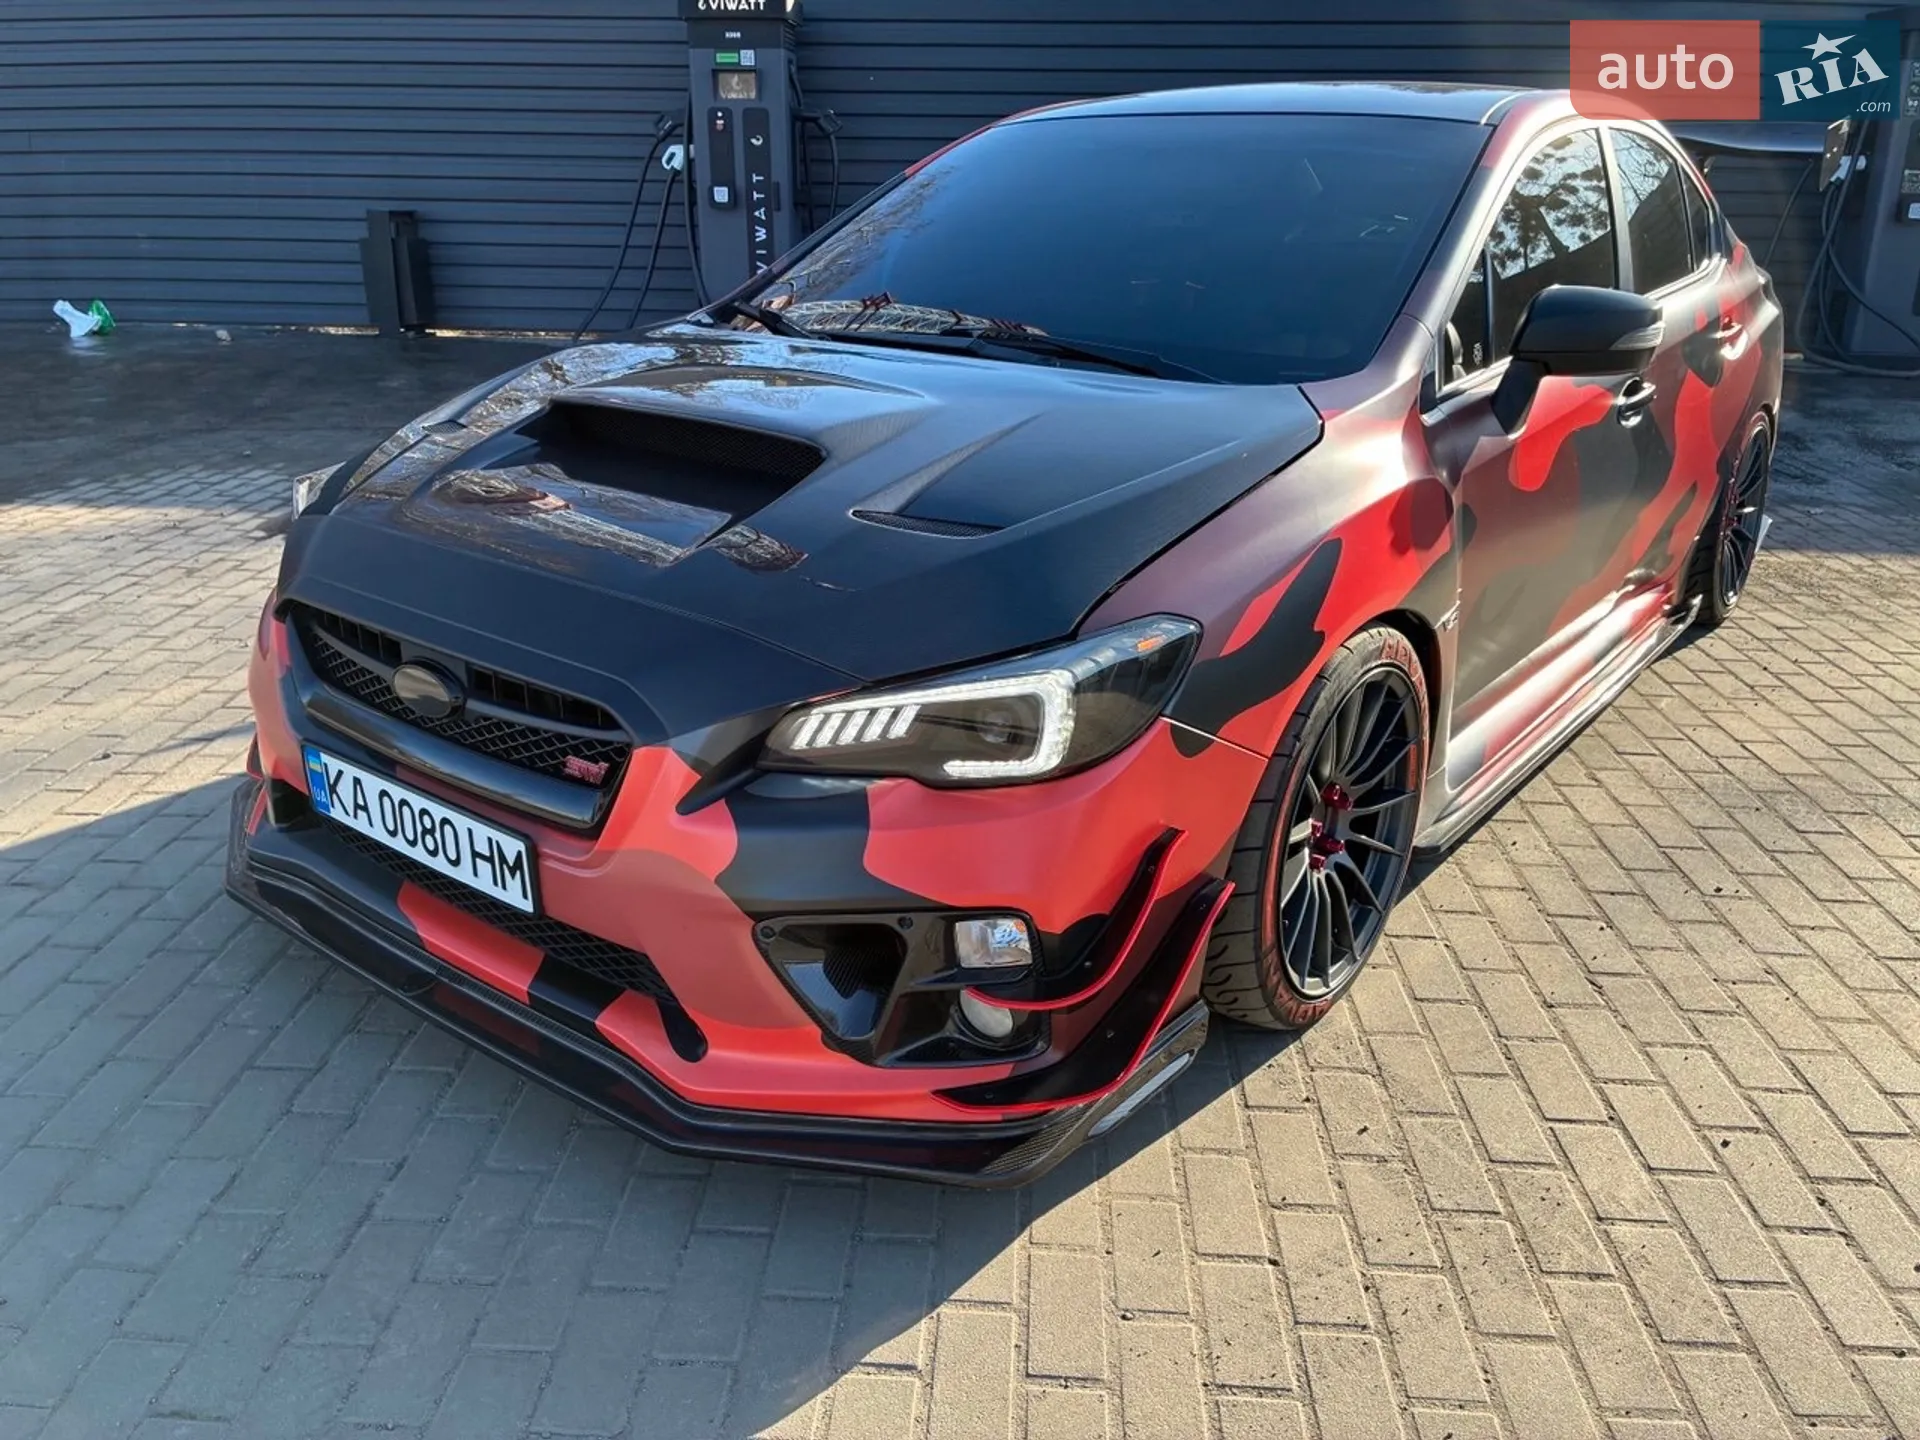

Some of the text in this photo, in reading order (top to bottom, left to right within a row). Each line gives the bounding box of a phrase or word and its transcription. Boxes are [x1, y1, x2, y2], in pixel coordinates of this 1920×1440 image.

[752, 172, 768, 275] VIWATT
[323, 762, 528, 900] KA 0080 HM
